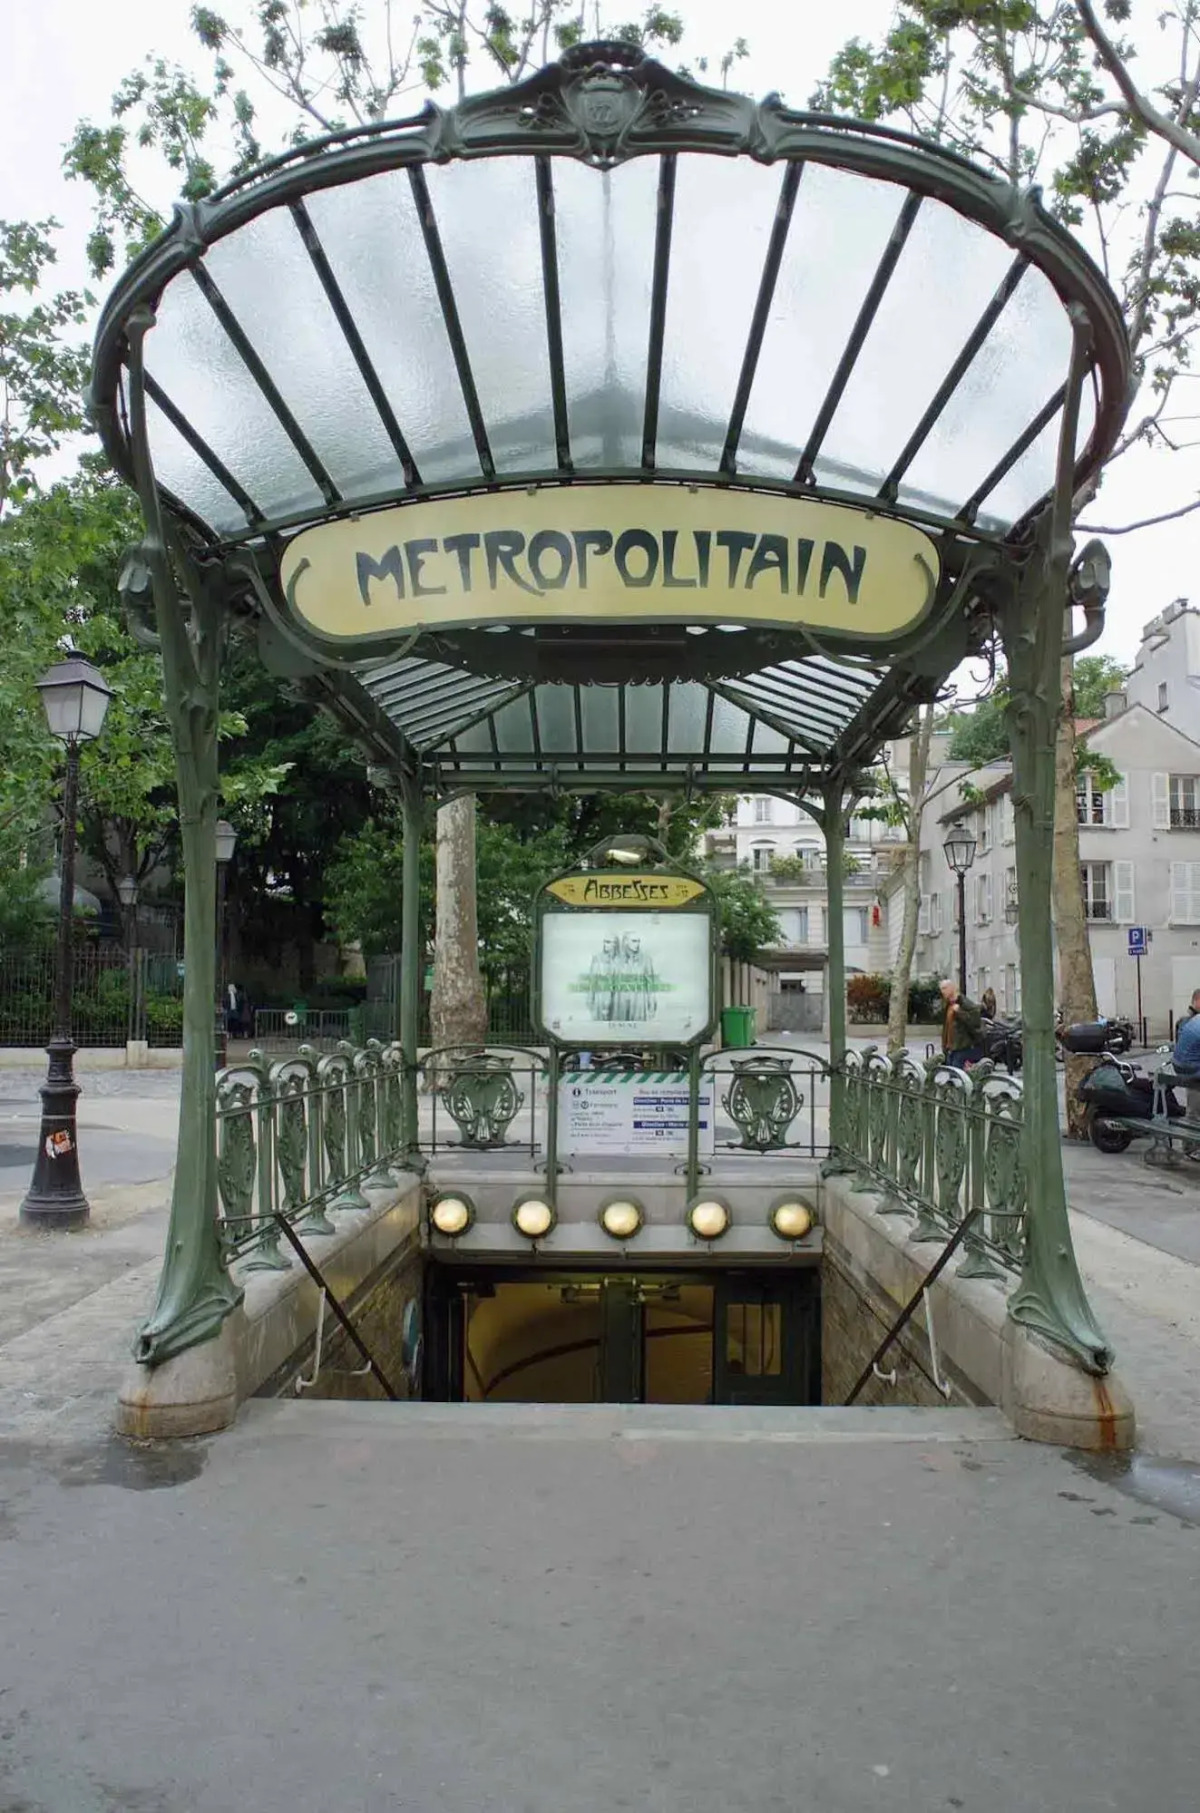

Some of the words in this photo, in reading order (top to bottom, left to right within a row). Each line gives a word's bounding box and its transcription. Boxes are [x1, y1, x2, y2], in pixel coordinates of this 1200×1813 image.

[355, 528, 867, 606] METROPOLITAIN
[584, 878, 668, 902] ABBESSES
[1132, 931, 1139, 942] P
